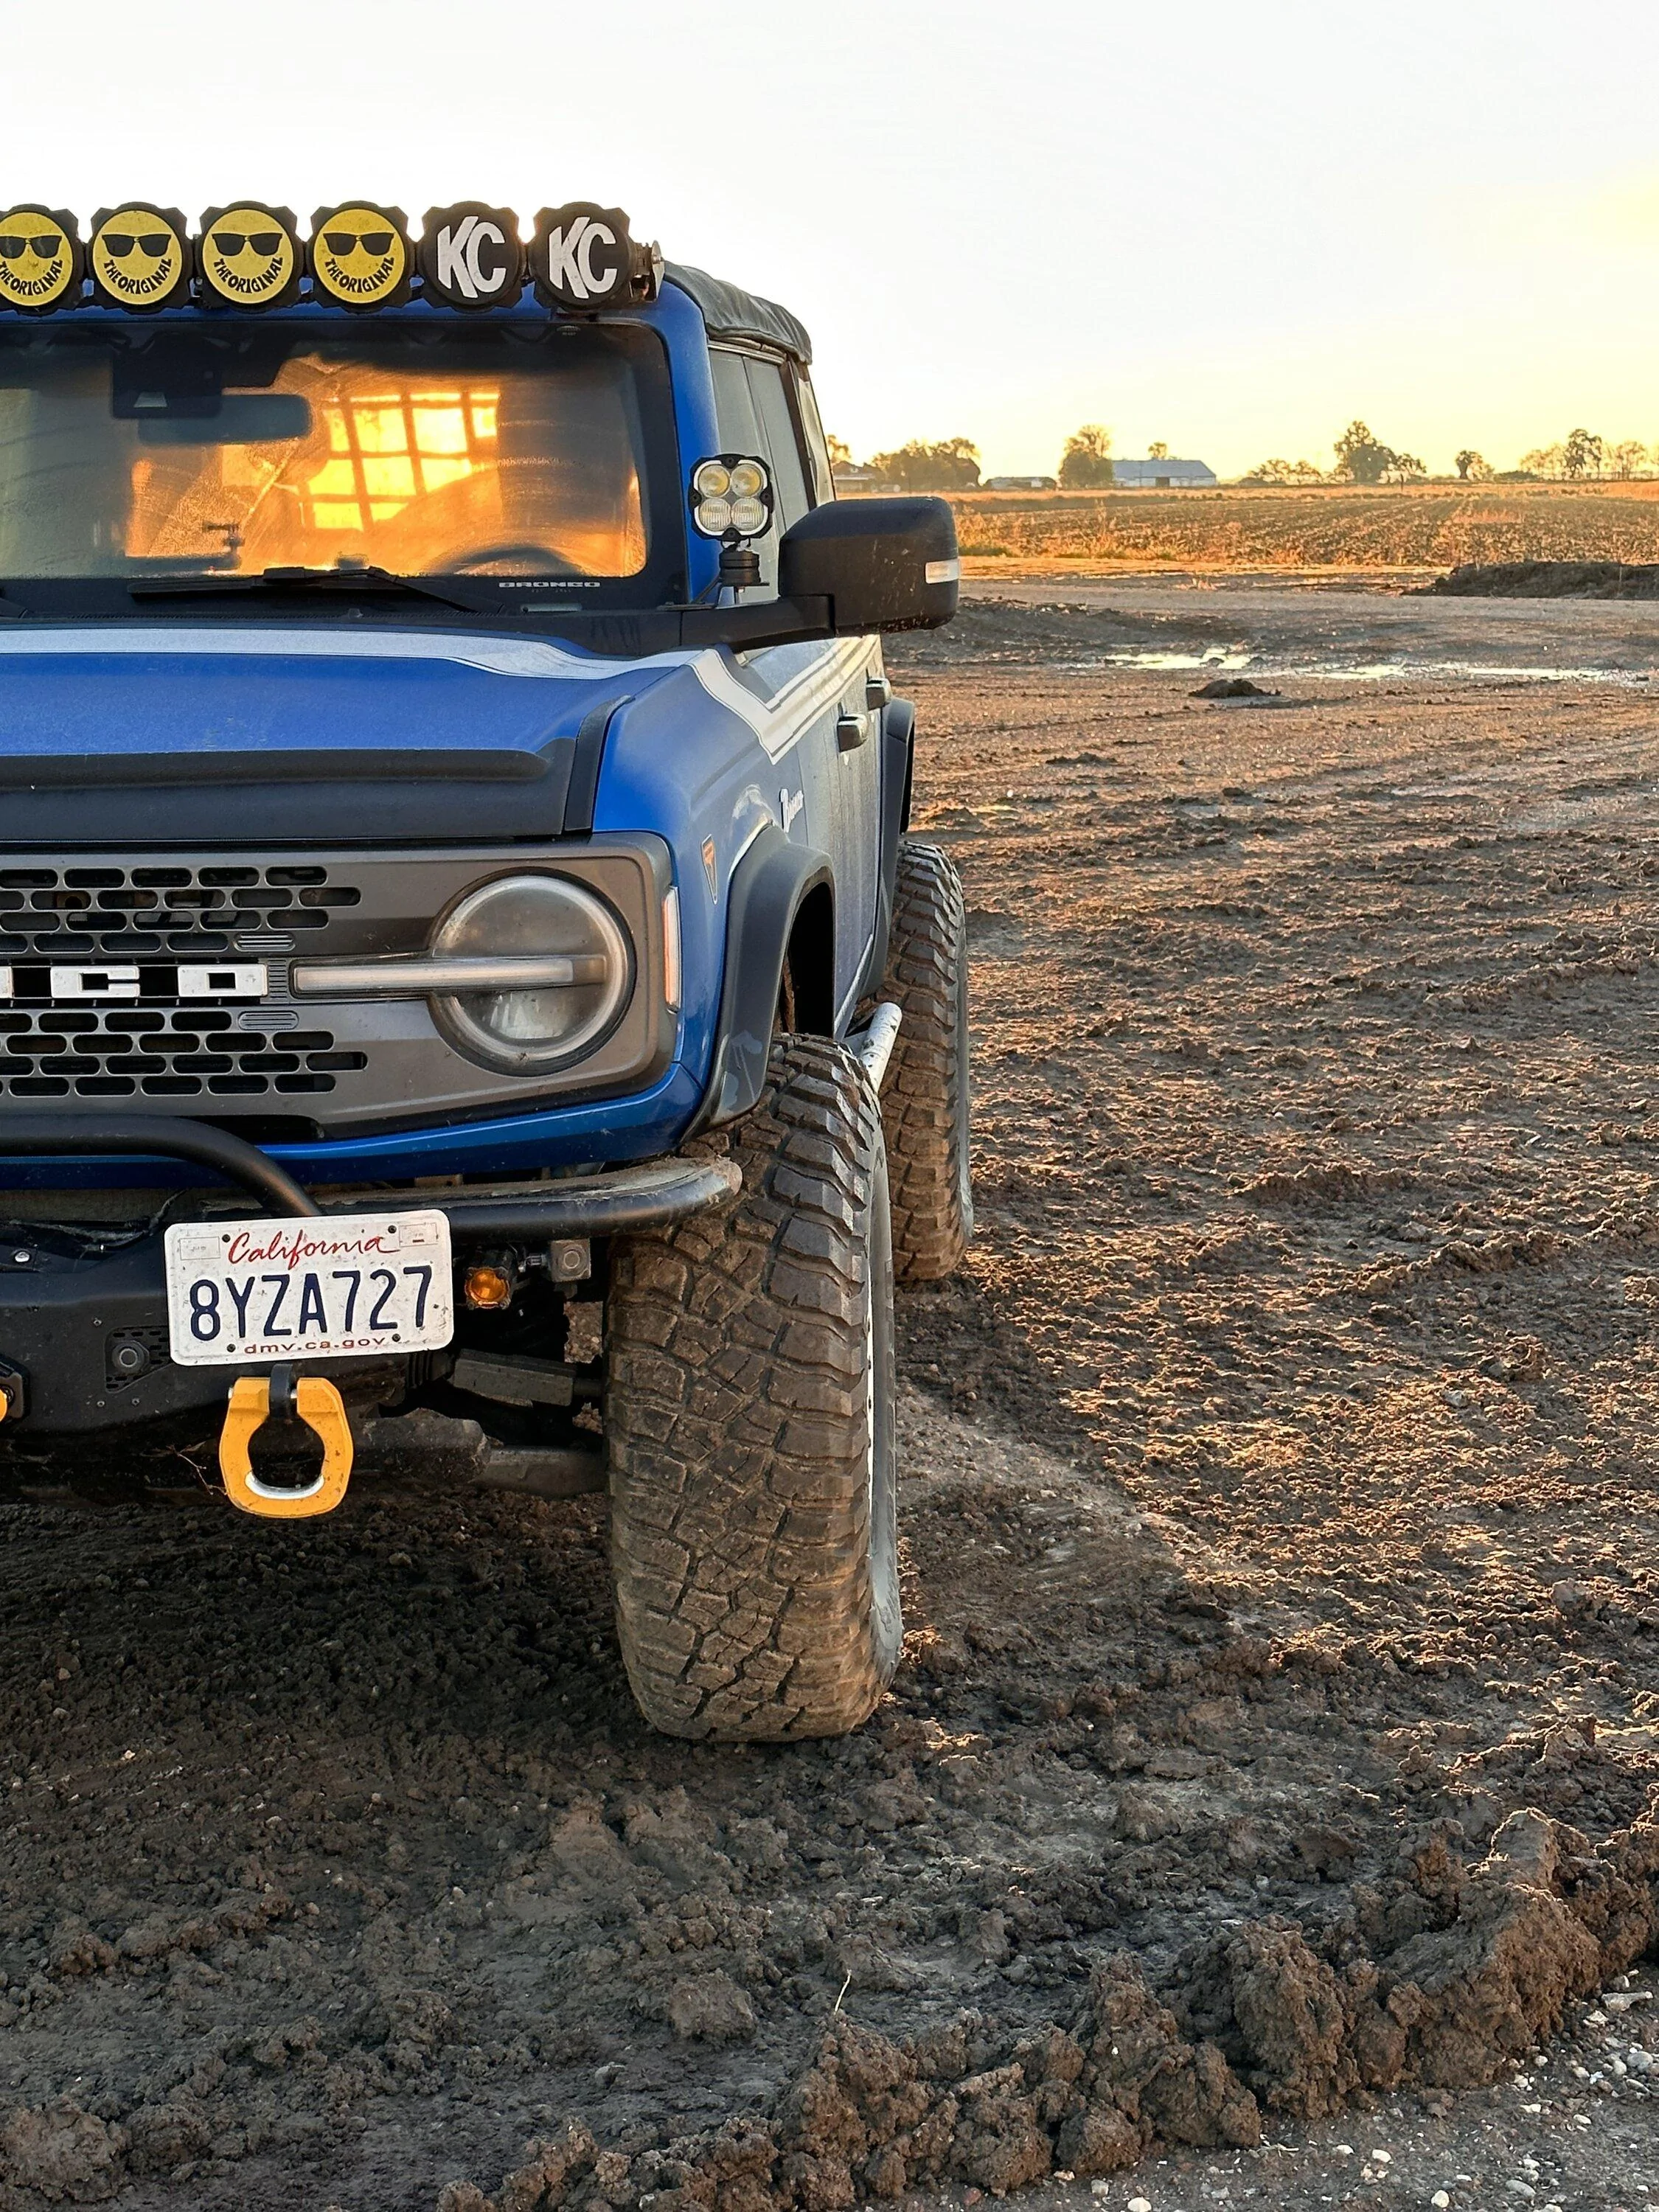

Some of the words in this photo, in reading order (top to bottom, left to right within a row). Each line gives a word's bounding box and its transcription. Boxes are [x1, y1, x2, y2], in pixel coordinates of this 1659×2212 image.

[437, 215, 507, 299] KC
[549, 216, 618, 299] KC
[0, 964, 268, 999] CO
[228, 1229, 400, 1270] California
[189, 1265, 433, 1342] 8YZA727
[244, 1335, 386, 1354] dmv.ca.gov
